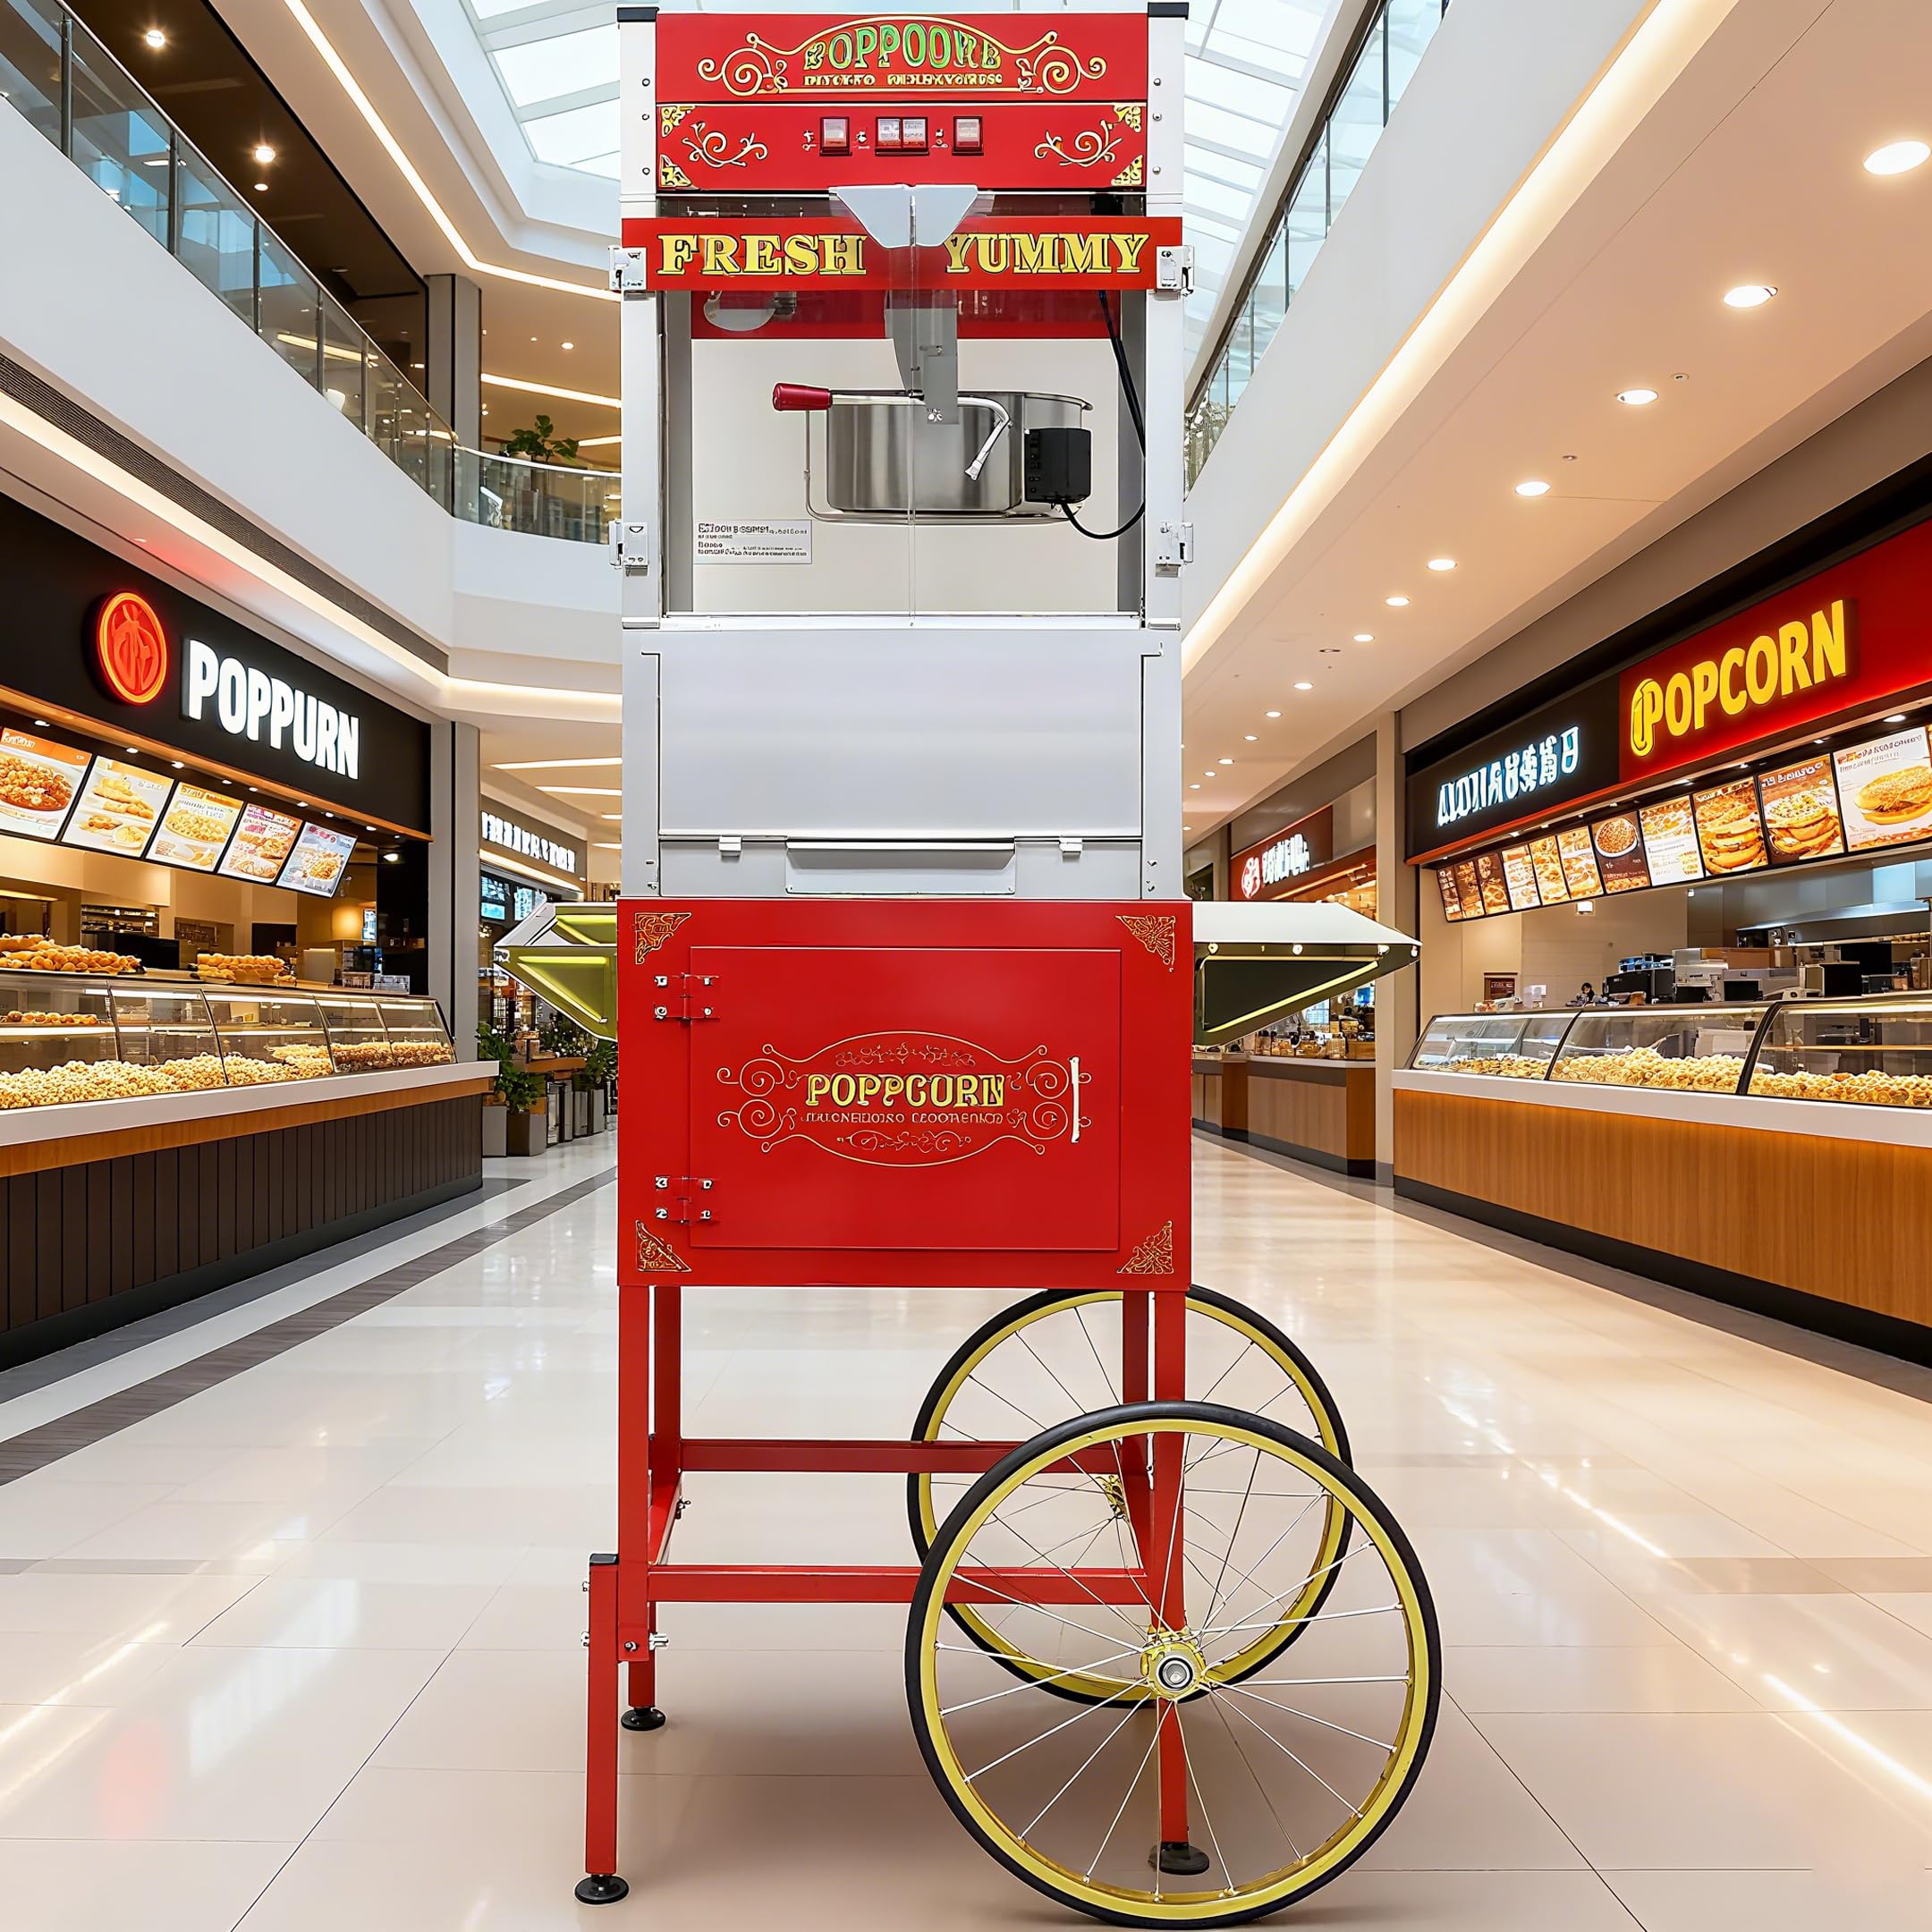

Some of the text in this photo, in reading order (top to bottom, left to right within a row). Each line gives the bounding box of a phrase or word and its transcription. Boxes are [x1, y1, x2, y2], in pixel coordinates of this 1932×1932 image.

[657, 233, 1150, 275] FRESH YUMMY
[188, 640, 360, 780] POPPURN
[1631, 600, 1847, 757] POPCORN
